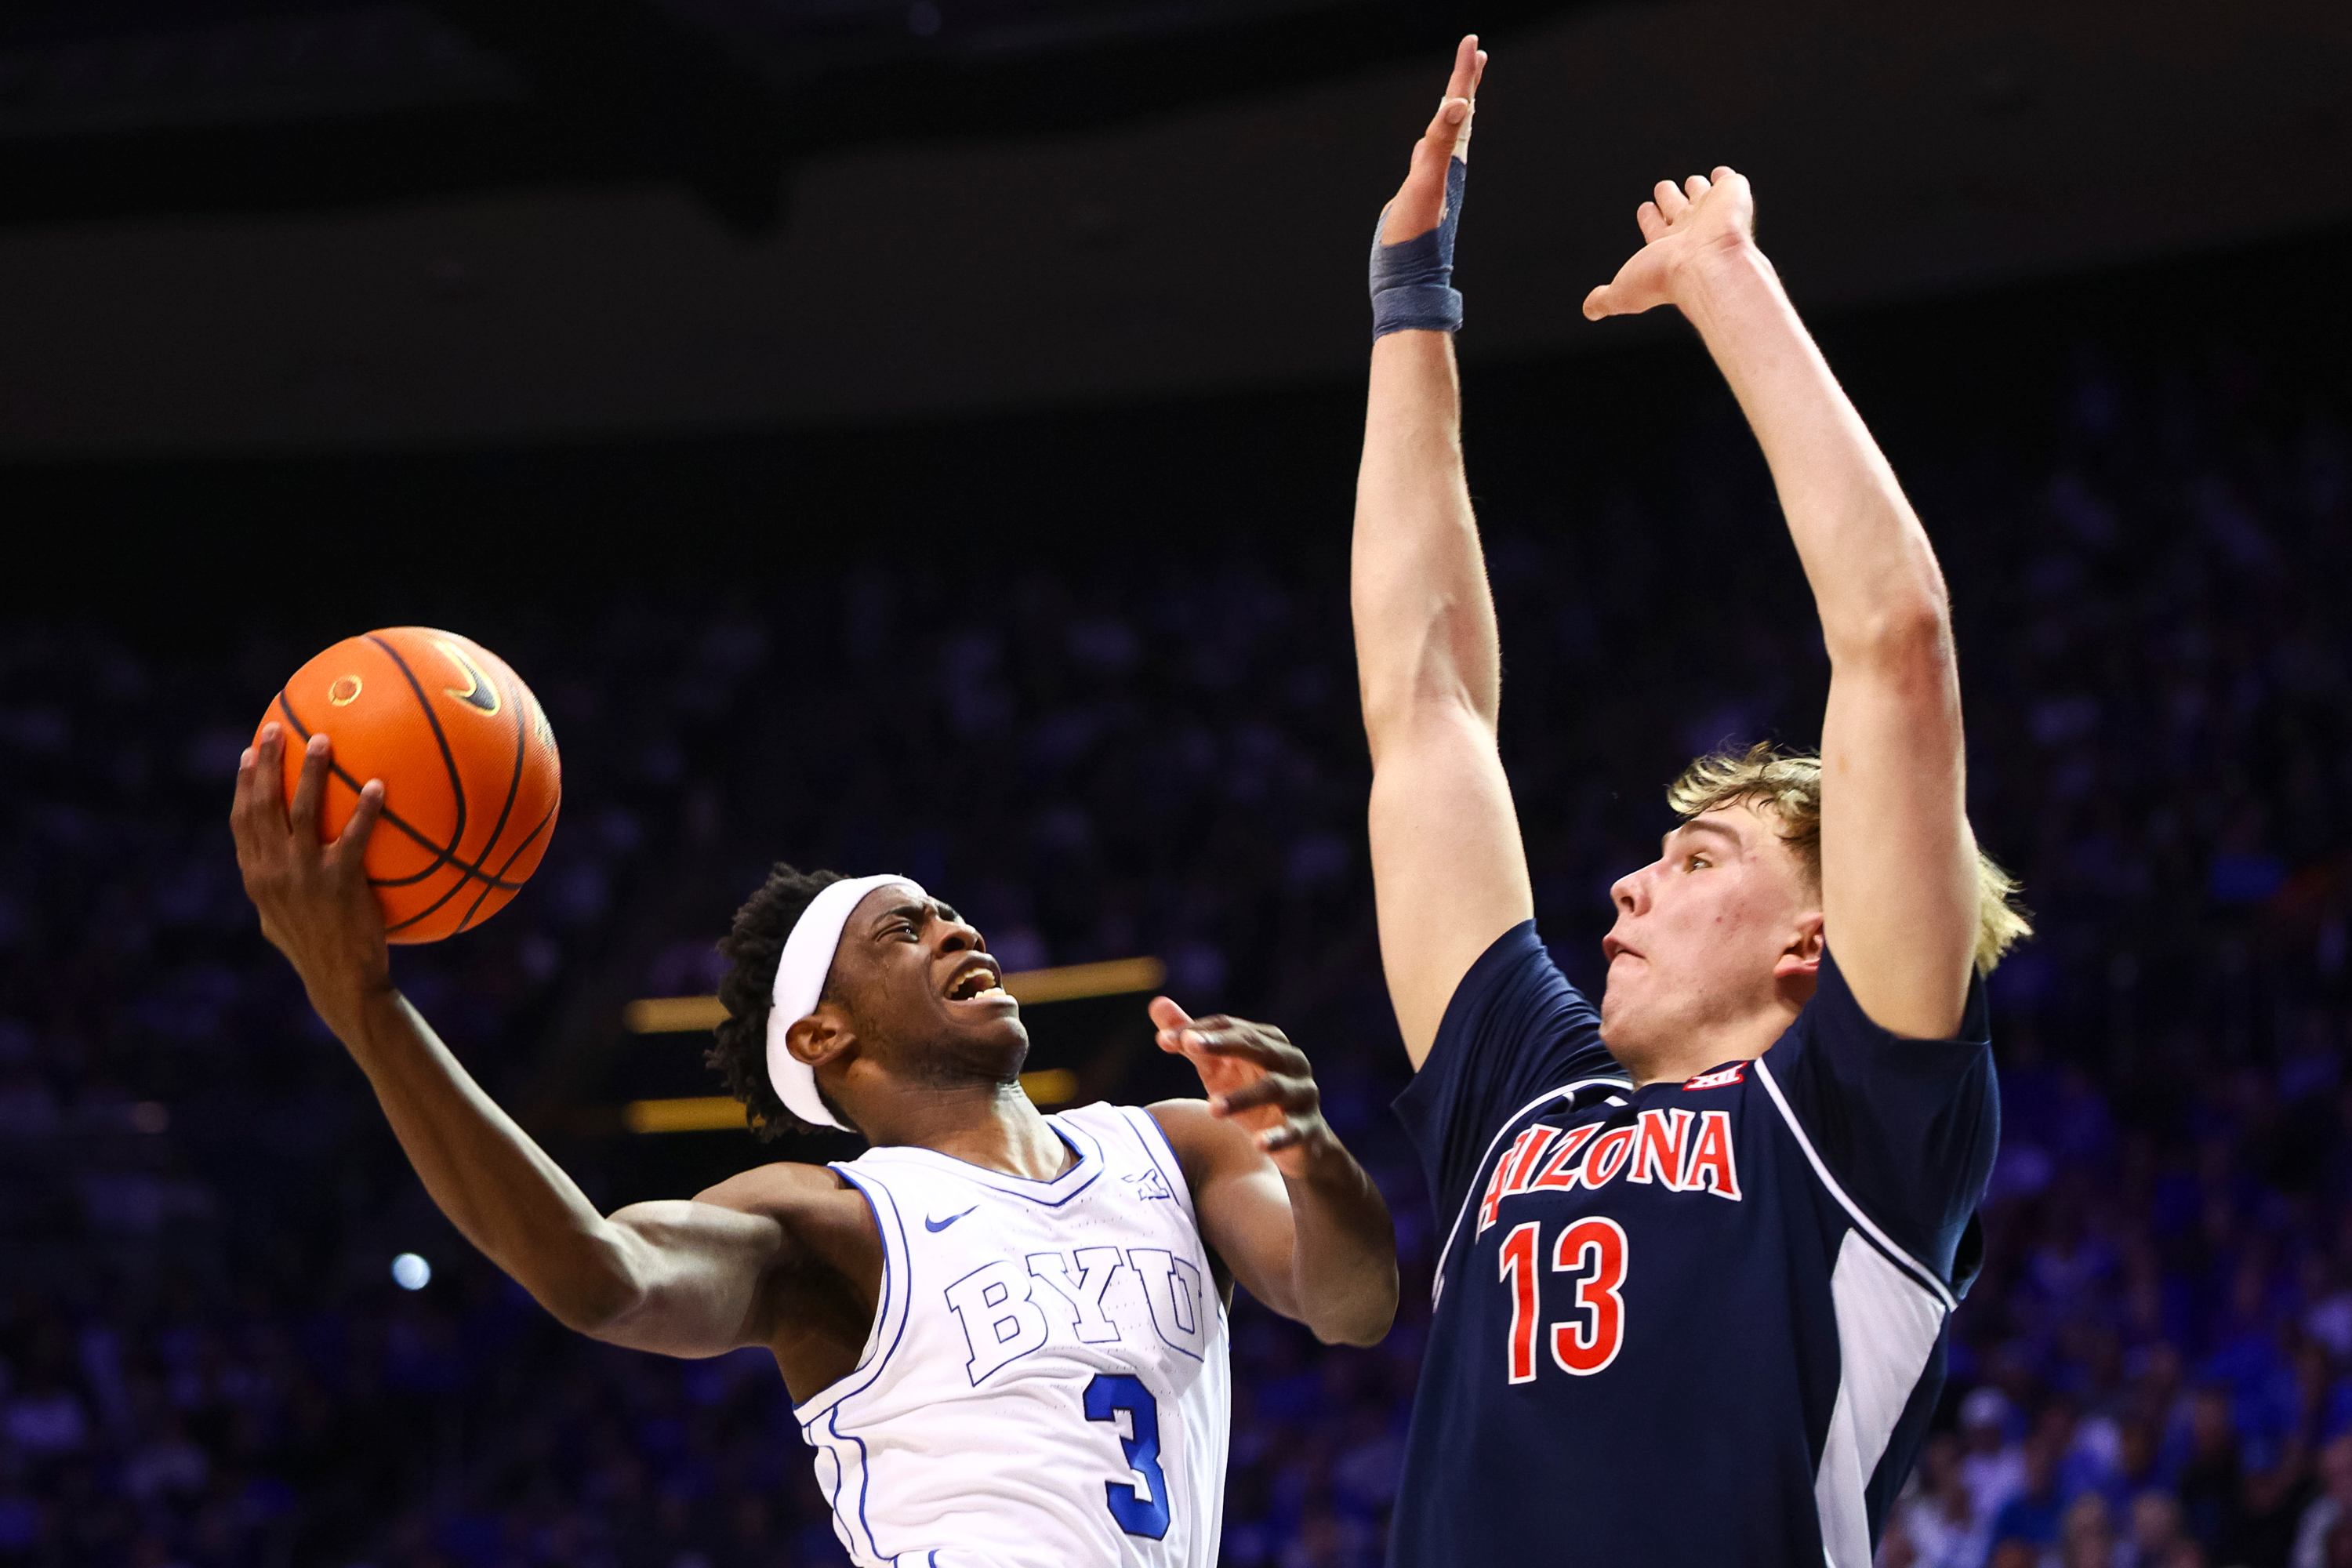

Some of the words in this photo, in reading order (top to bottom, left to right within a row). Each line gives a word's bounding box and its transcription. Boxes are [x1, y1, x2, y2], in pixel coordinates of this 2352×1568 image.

[944, 1247, 1205, 1387] BYU
[1499, 1216, 1628, 1385] 13
[1083, 1374, 1171, 1541] 3
